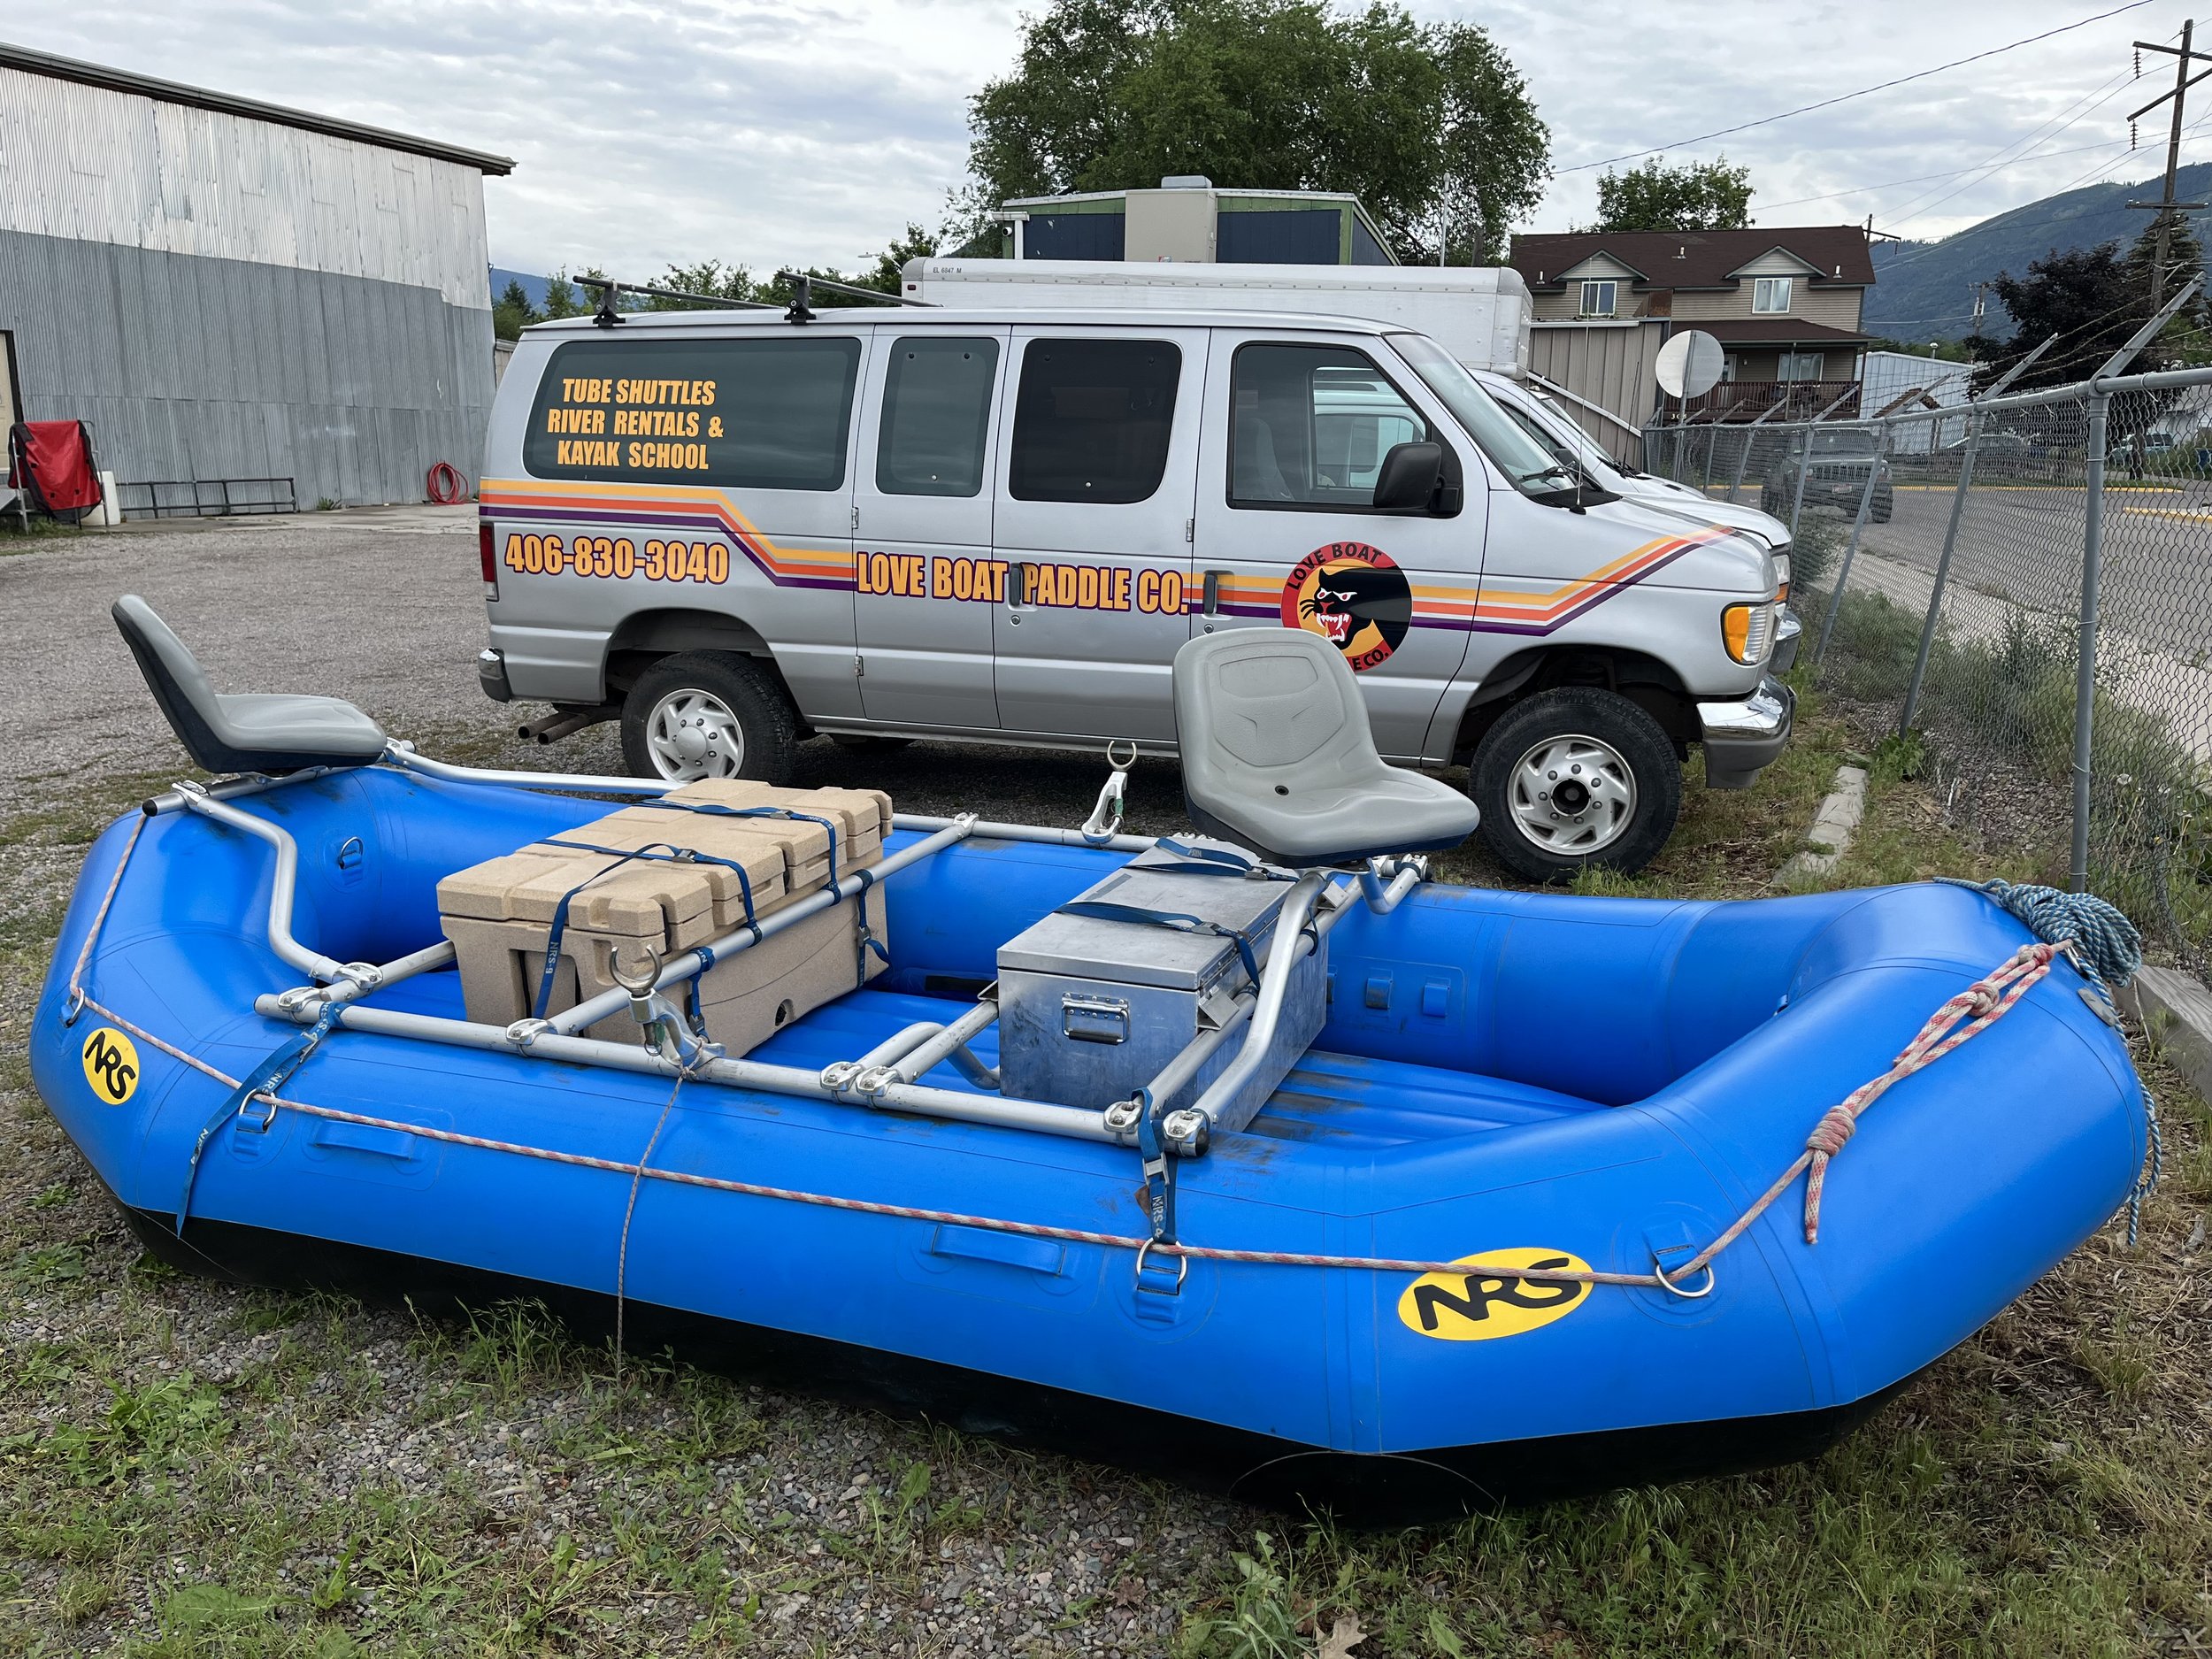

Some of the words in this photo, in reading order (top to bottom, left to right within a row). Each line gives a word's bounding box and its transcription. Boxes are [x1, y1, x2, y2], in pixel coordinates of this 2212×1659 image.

[563, 378, 613, 403] TUBE
[616, 379, 717, 406] SHUTTLES
[547, 409, 605, 434] RIVER
[613, 410, 700, 437] RENTALS
[707, 416, 724, 438] &
[557, 440, 620, 466] KAYAK
[628, 442, 709, 470] SCHOOL
[504, 534, 730, 584] 406-830-3040
[1286, 549, 1326, 591] LOVE
[1331, 543, 1382, 565] BOAT
[856, 552, 926, 597] LOVE
[933, 557, 1009, 603] BOAT
[1020, 561, 1131, 611] PADDLE
[1137, 569, 1190, 615] CO.
[1363, 649, 1389, 666] CO.
[84, 1031, 136, 1100] NRS
[1413, 1257, 1582, 1331] NRS
